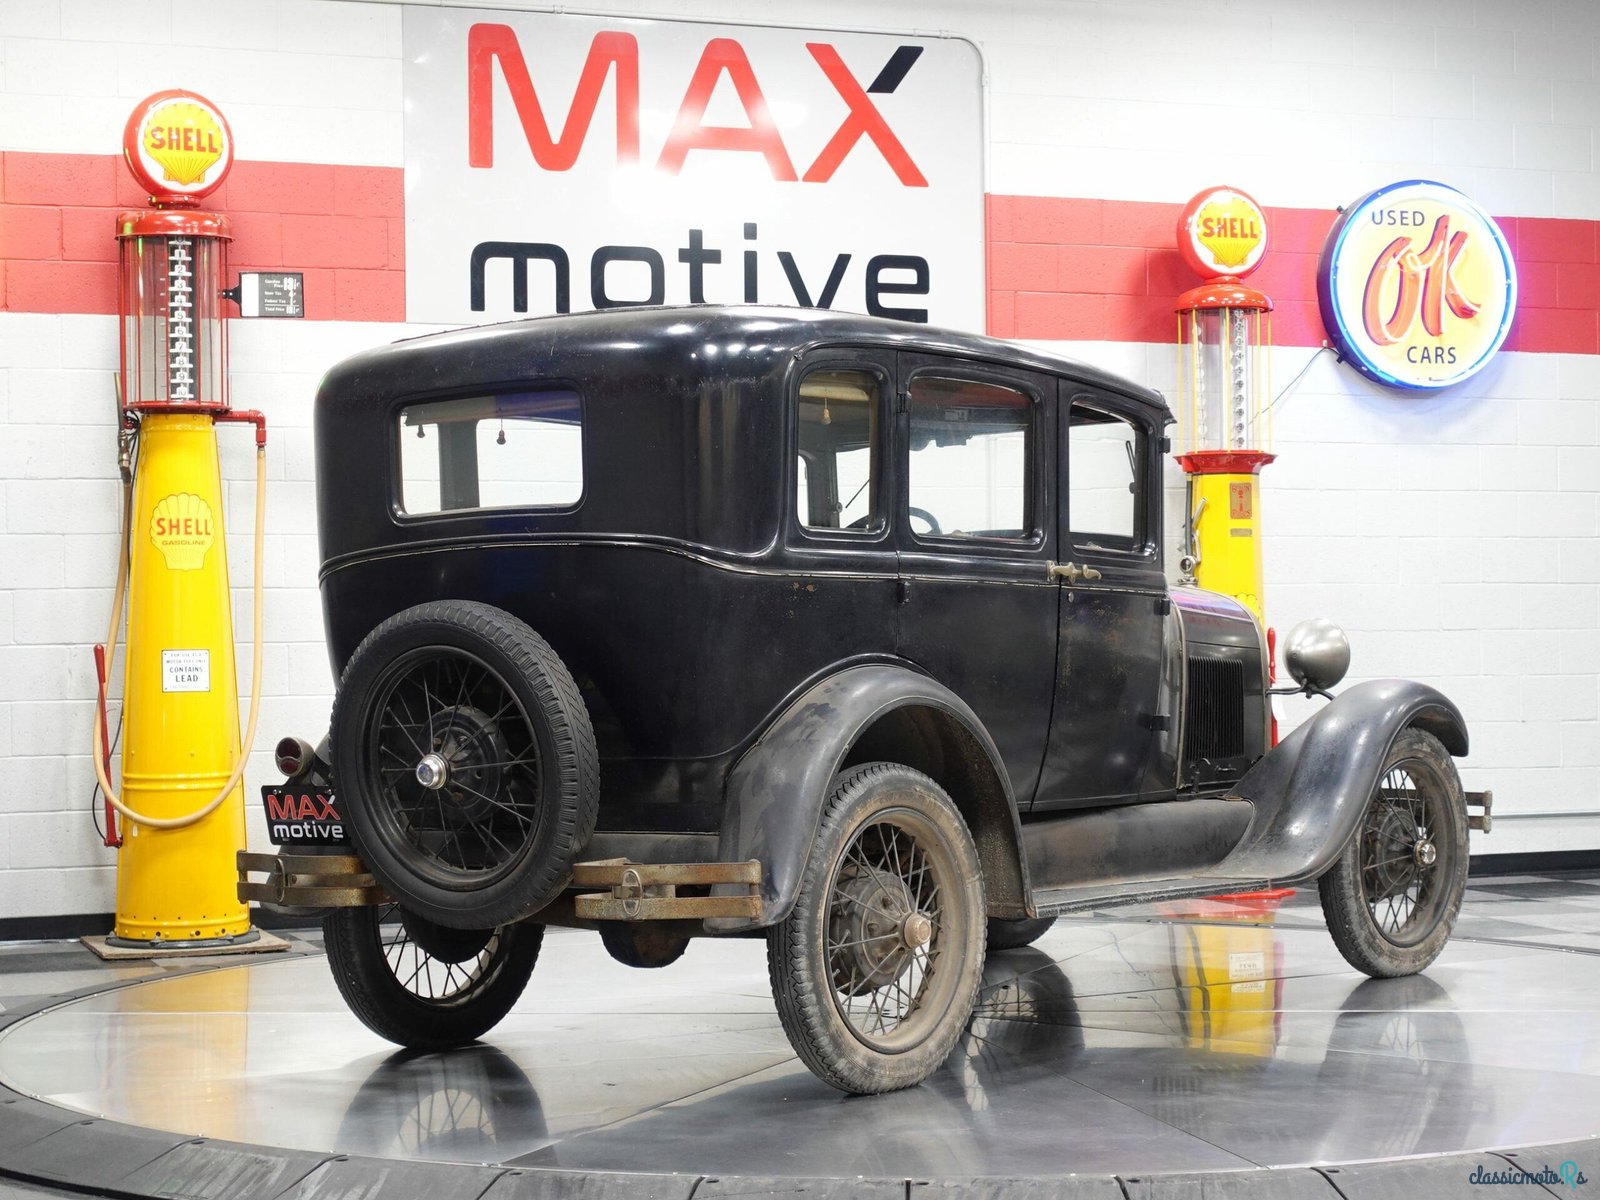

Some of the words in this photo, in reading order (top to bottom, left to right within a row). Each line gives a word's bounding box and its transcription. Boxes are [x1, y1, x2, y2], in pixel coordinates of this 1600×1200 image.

[468, 22, 929, 187] MAX
[150, 126, 218, 154] SHELL
[1202, 217, 1258, 239] SHELL
[1371, 209, 1425, 227] USED
[470, 222, 930, 323] motive
[1362, 214, 1481, 346] OK
[1407, 346, 1457, 364] CARS
[156, 517, 211, 536] SHELL
[175, 674, 199, 682] LEAD
[267, 794, 341, 820] MAX
[273, 820, 344, 838] motive
